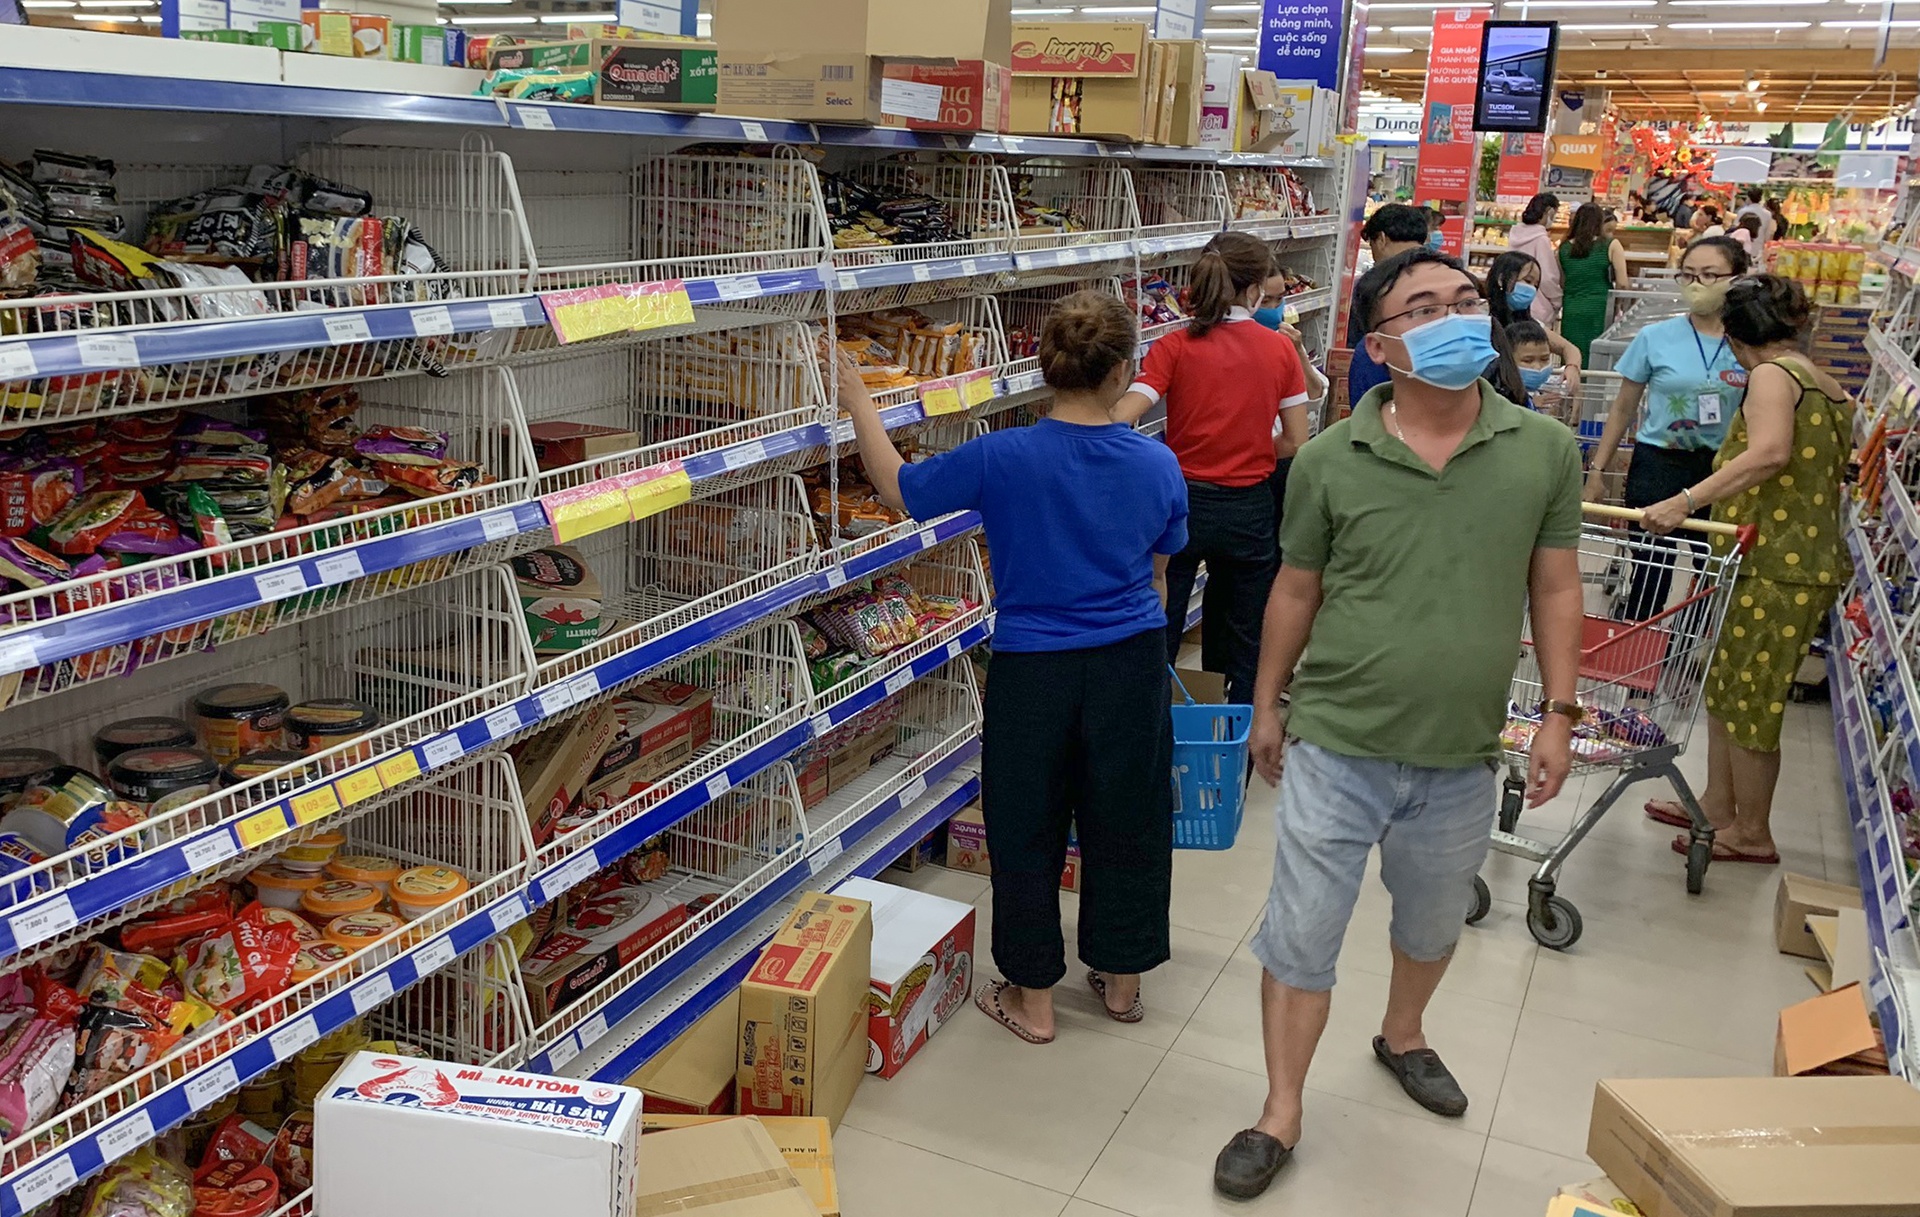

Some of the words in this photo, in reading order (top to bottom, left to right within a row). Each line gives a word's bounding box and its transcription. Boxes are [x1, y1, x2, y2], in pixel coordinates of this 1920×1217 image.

[1278, 4, 1299, 17] Lựa
[1301, 4, 1328, 16] chọn
[1270, 18, 1301, 30] thông
[1304, 18, 1333, 29] minh,
[1273, 32, 1299, 44] cuộc
[1301, 31, 1327, 44] sống
[1293, 46, 1321, 58] dàng
[1560, 143, 1597, 155] QUAY
[456, 1069, 483, 1082] MÌ
[497, 1075, 534, 1089] HAI
[537, 1080, 580, 1096] TÔM
[455, 1102, 485, 1113] DOANH
[486, 1106, 516, 1117] NGHIỆP
[518, 1110, 541, 1121] XANH
[552, 1114, 575, 1126] CỘNG
[530, 1099, 565, 1117] HẢI
[568, 1104, 609, 1121] SẢN
